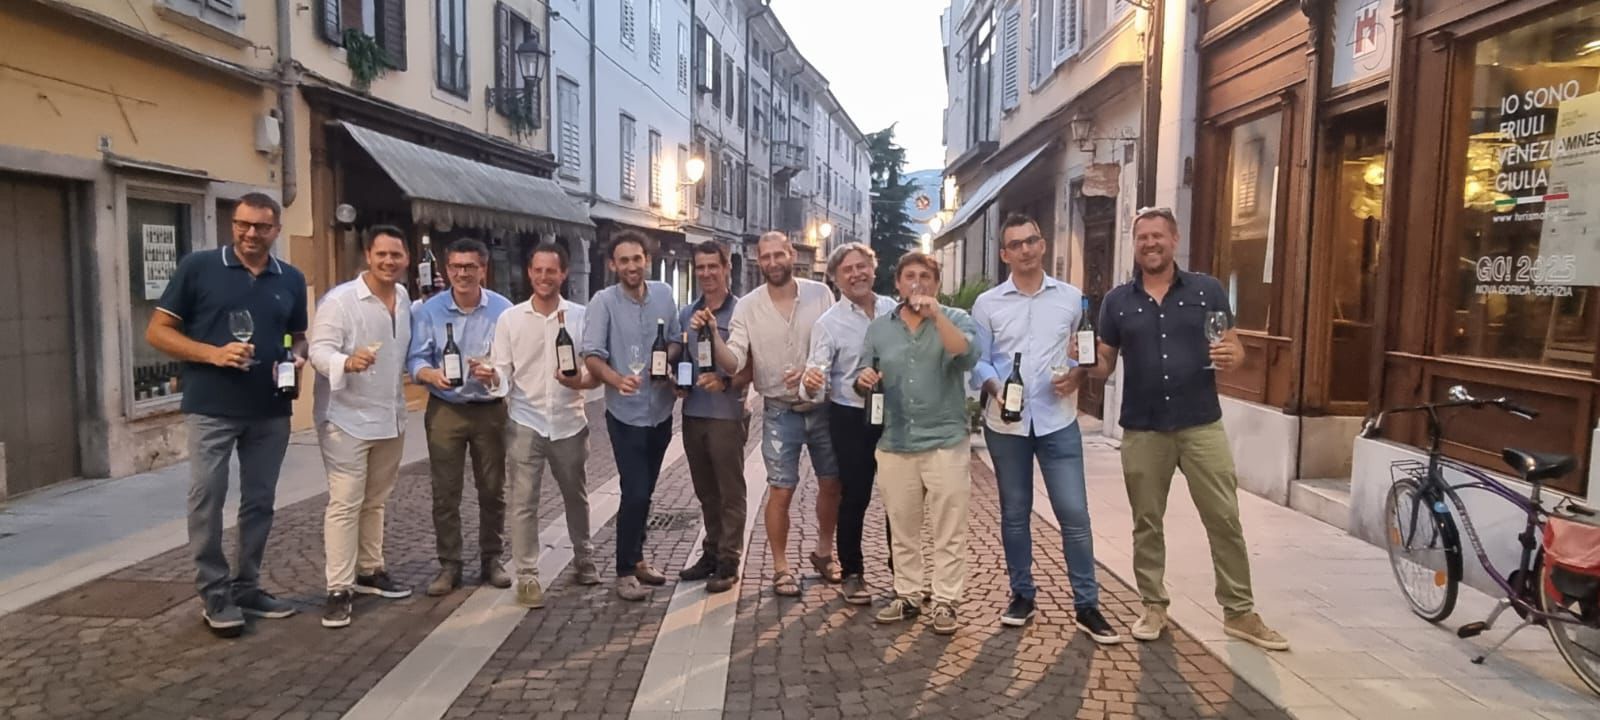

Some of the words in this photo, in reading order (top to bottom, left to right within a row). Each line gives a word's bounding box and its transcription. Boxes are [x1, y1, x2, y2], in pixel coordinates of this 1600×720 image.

[1500, 94, 1520, 116] IO
[1523, 80, 1580, 110] SONO
[1499, 114, 1545, 143] FRIULI
[1497, 138, 1567, 167] VENEZIA
[1495, 167, 1548, 193] GIULIA
[1475, 255, 1513, 282] GO!
[1515, 254, 1577, 283] 2025
[1475, 284, 1498, 295] NOVA
